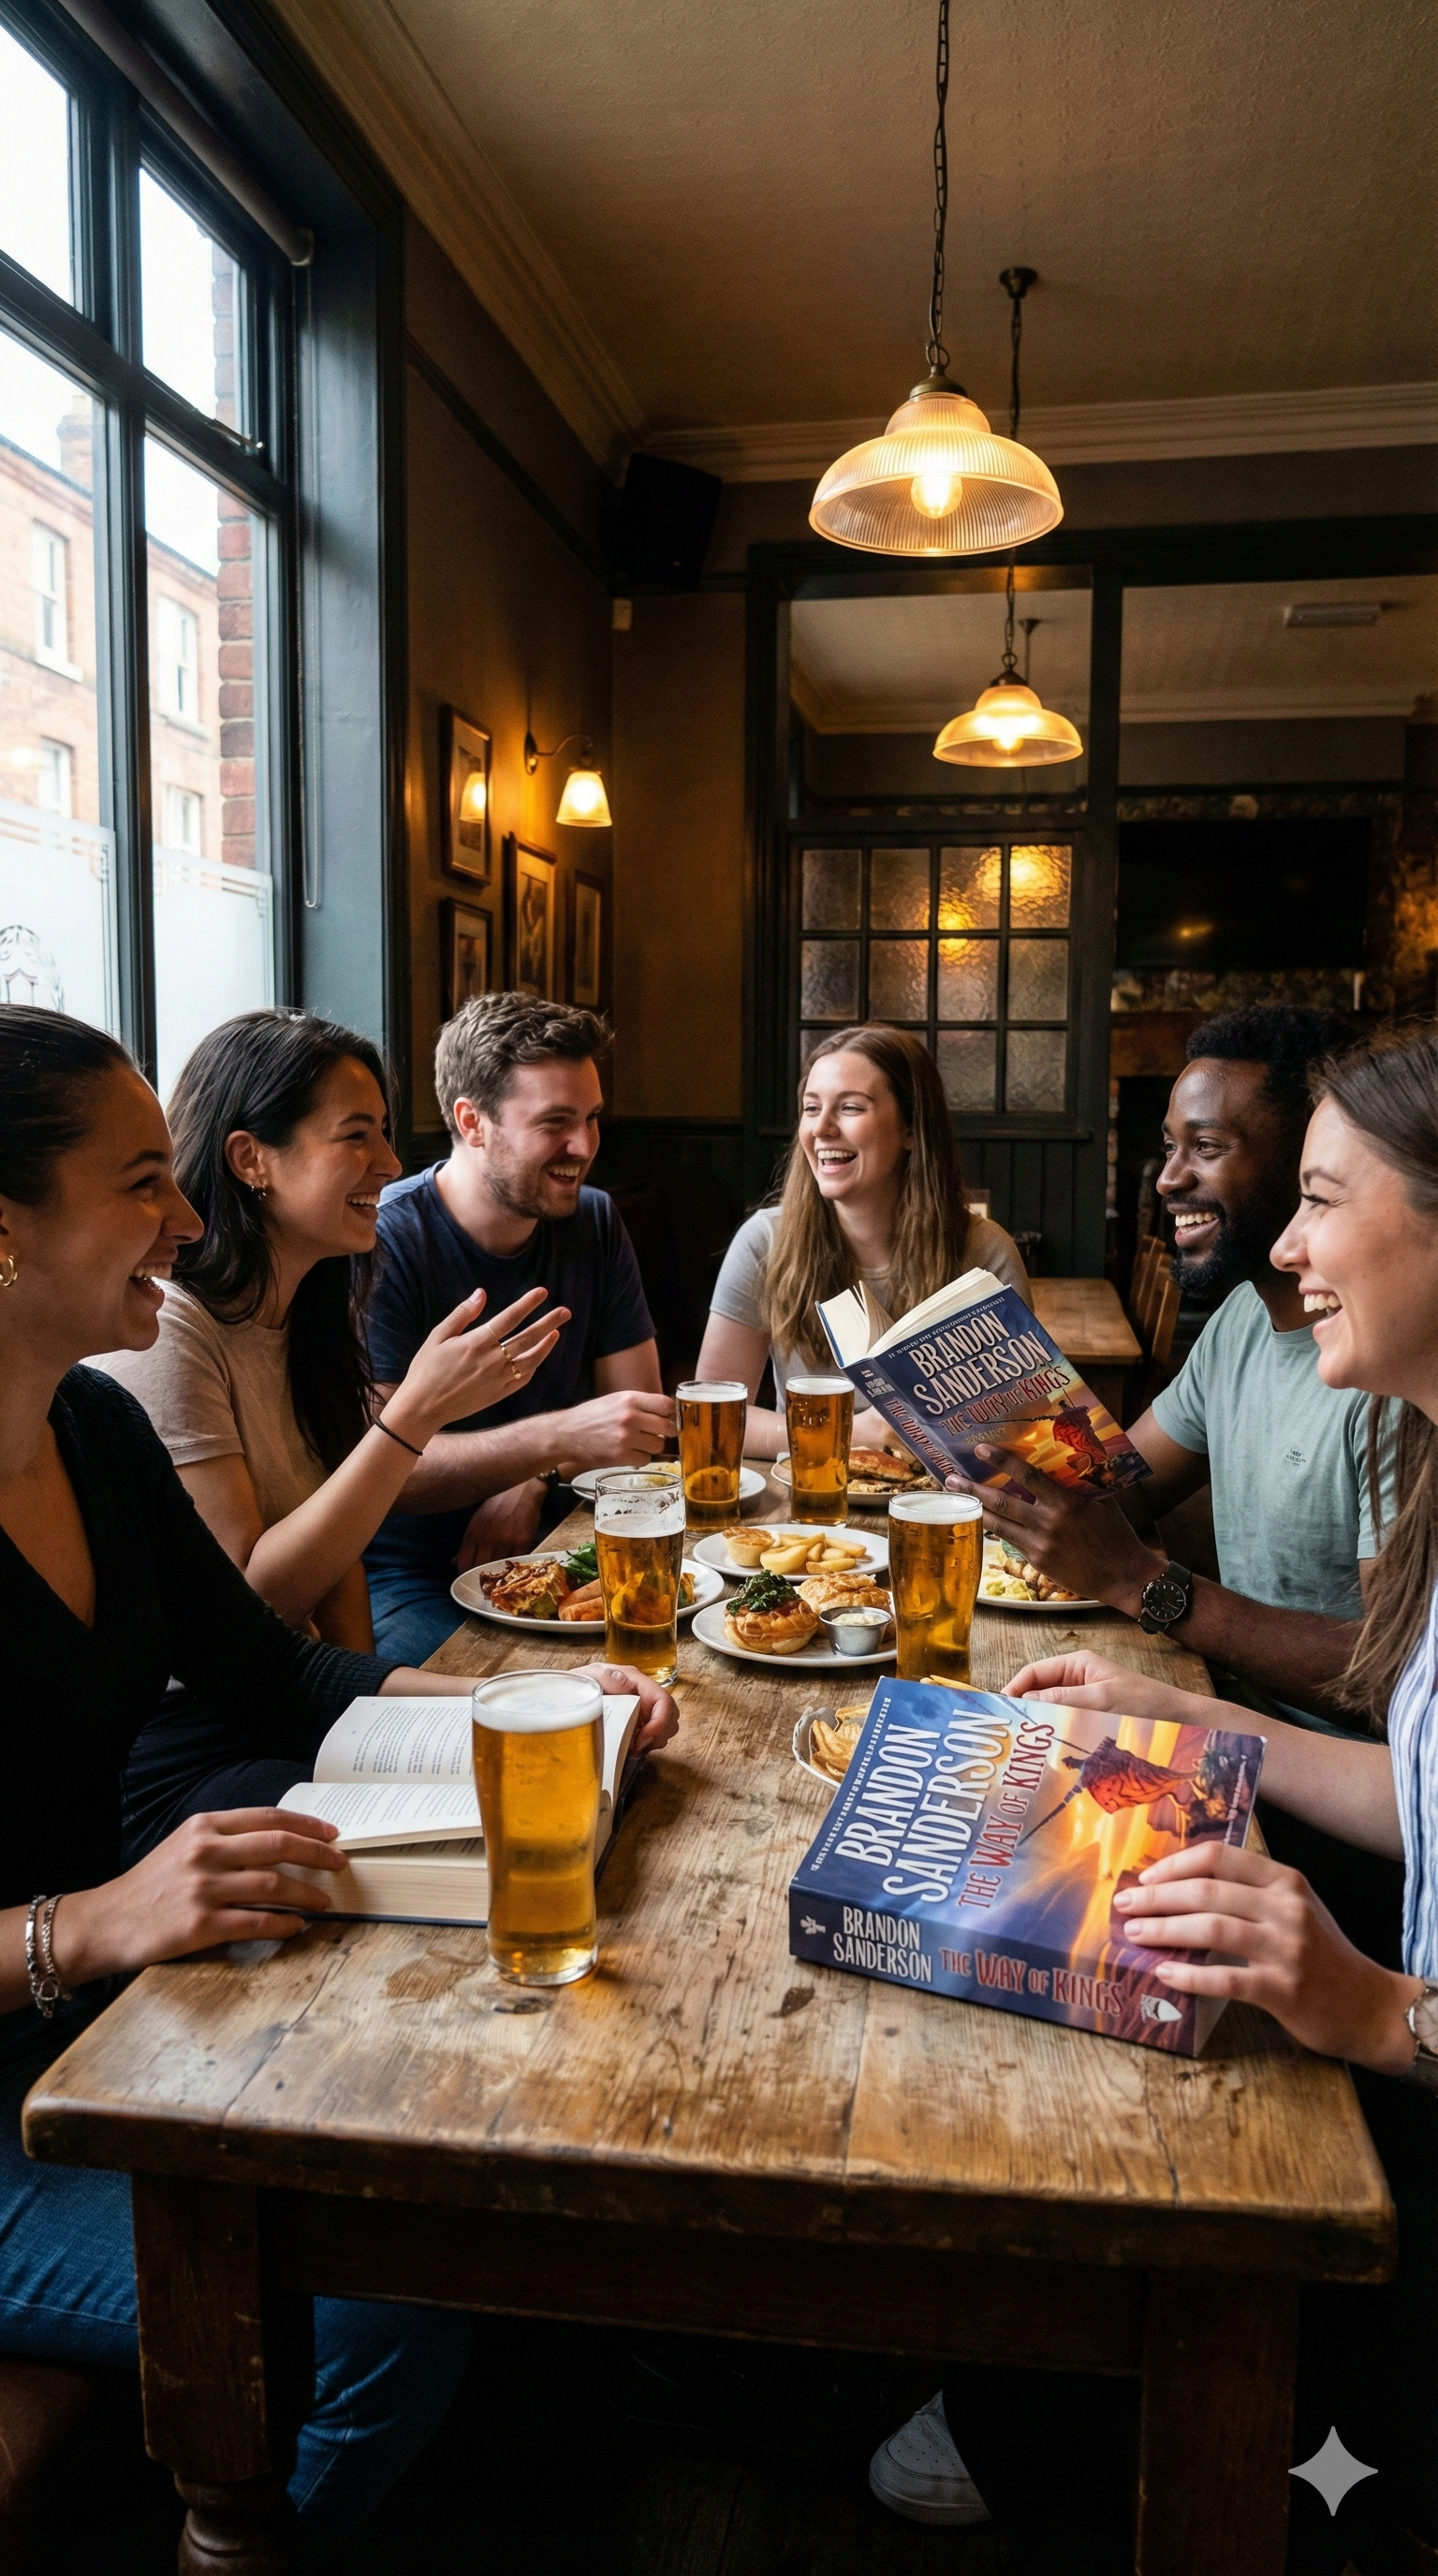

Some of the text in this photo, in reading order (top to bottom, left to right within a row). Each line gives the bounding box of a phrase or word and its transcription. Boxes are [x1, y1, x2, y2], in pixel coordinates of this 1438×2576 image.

[908, 1310, 1010, 1379] BRANDON
[913, 1330, 1052, 1415] SANDERSON
[940, 1411, 973, 1436] THE
[965, 1392, 1010, 1424] WAY
[1017, 1366, 1070, 1401] KINGS
[834, 1723, 941, 1866] BRANDON
[882, 1708, 1012, 1903] SANDERSON
[958, 1721, 1055, 1909] THE WAY OF KINGS
[832, 1932, 932, 1983] SANDERSON
[843, 1906, 920, 1951] BRANDON
[940, 1947, 1124, 2016] THE WAY OF KINGS
